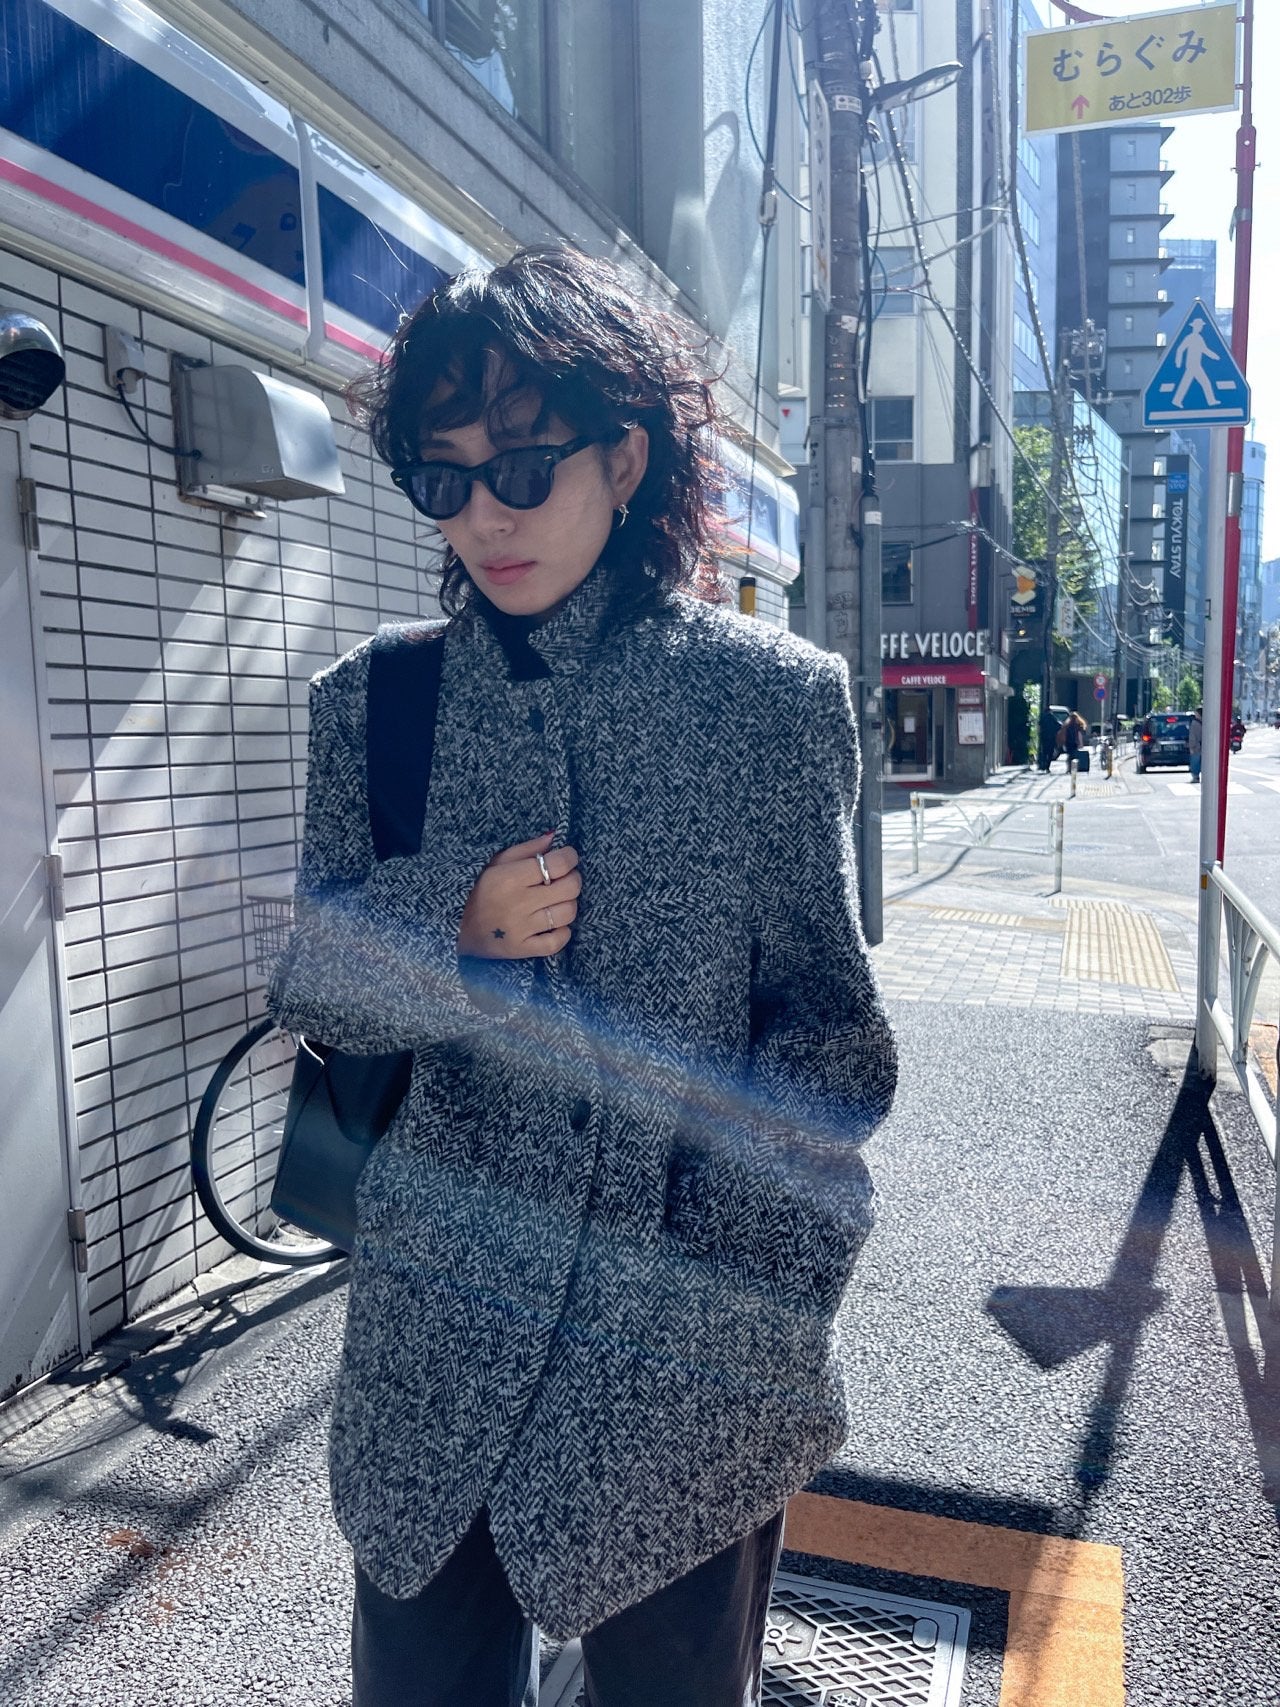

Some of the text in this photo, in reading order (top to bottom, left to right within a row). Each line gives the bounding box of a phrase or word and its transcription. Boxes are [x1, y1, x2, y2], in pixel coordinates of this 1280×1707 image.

[1052, 30, 1207, 82] むらぐみ
[1108, 86, 1192, 112] あと302歩
[1170, 498, 1184, 544] TOKYU
[1169, 545, 1182, 579] STAY
[915, 631, 985, 658] VELOCE
[922, 675, 946, 685] VELOCE
